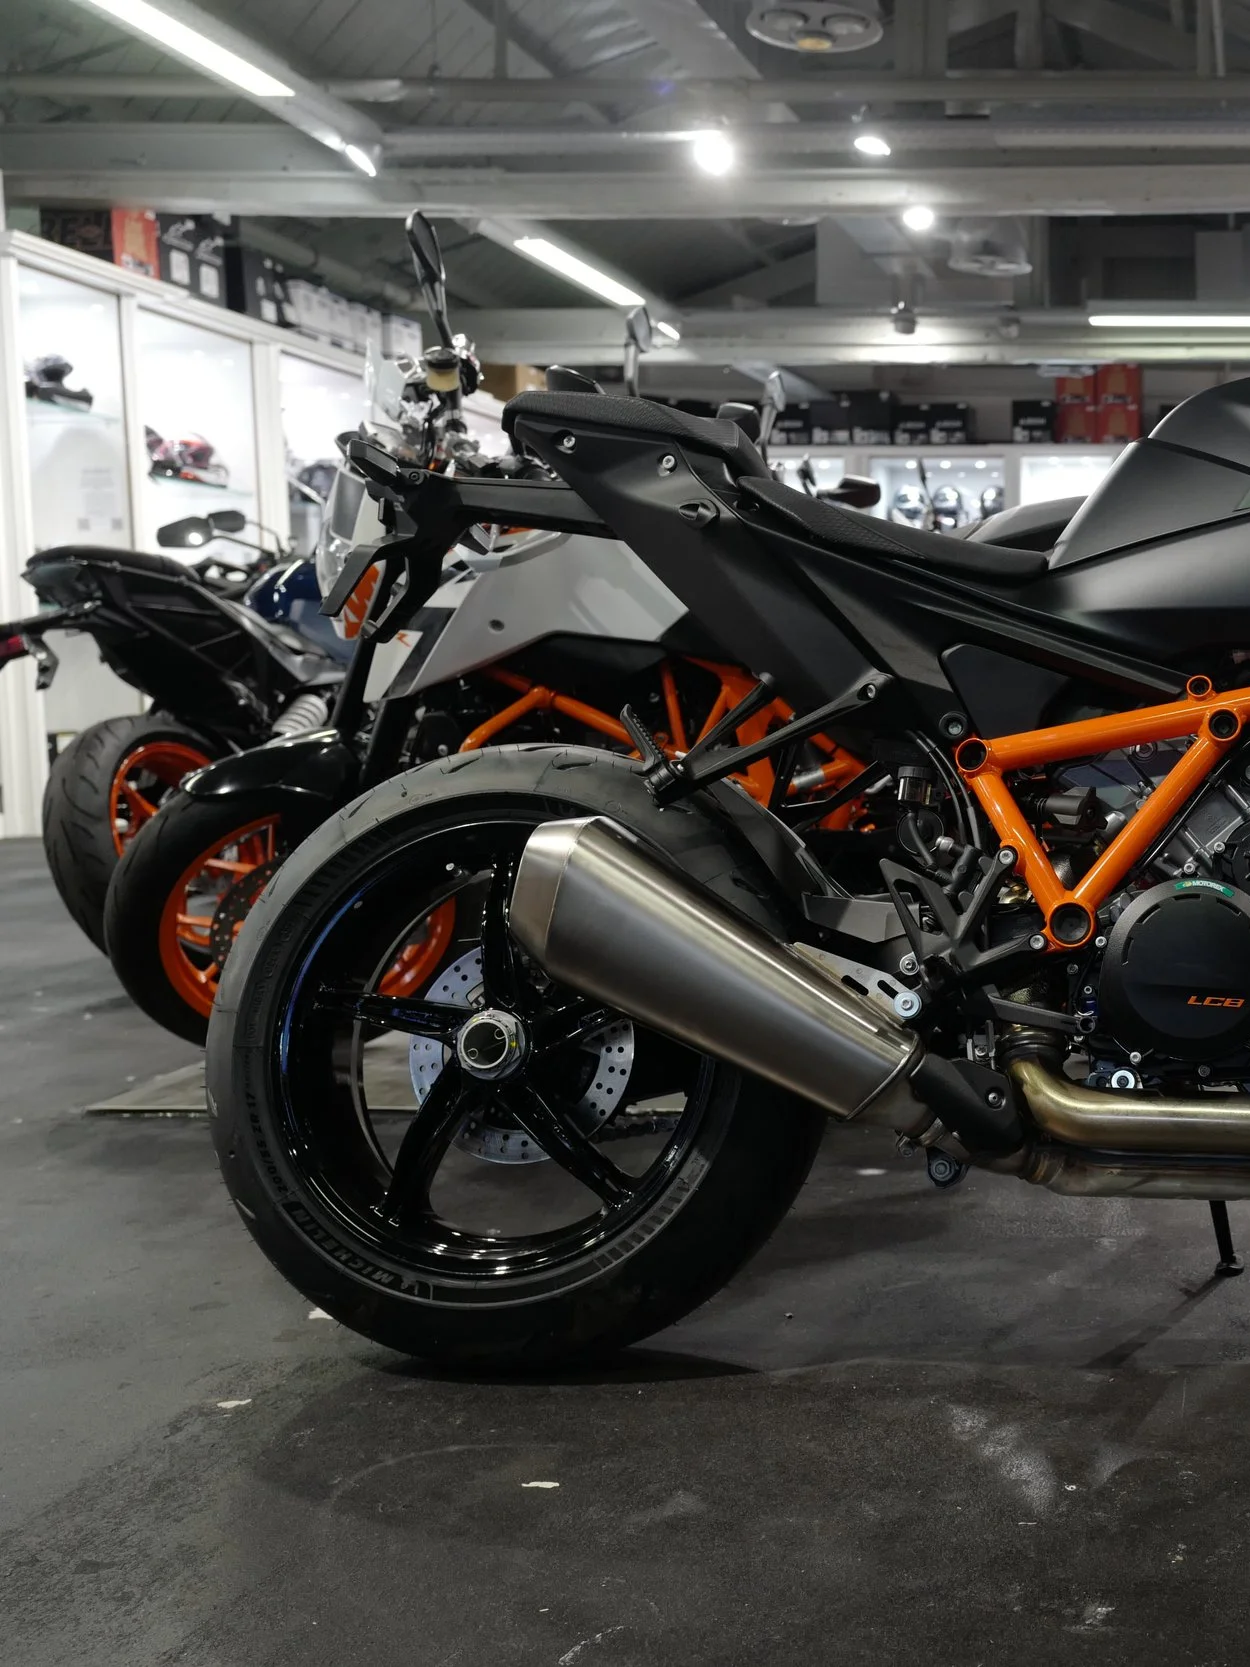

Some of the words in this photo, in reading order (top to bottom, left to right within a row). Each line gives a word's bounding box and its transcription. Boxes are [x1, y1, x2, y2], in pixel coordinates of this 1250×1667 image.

[1191, 879, 1226, 893] MOTOREX
[1187, 995, 1245, 1008] LC8
[244, 1093, 257, 1111] 17
[255, 1140, 289, 1193] 200/55
[290, 1205, 397, 1288] MICHELIN
